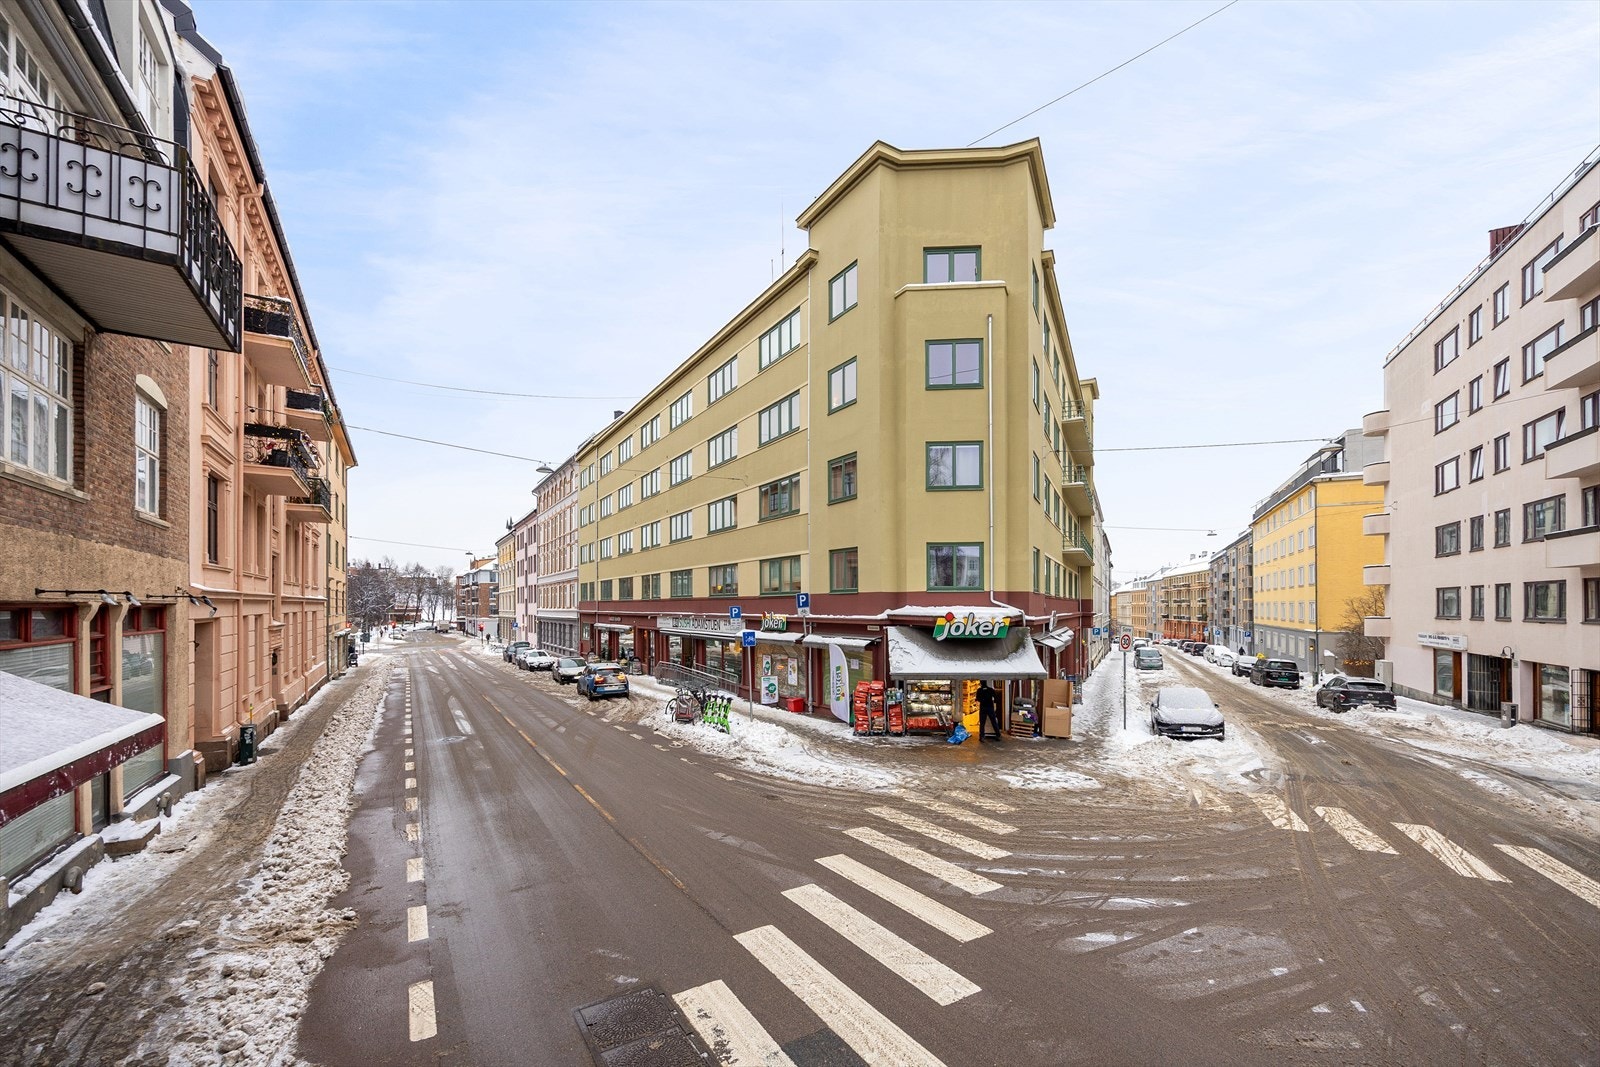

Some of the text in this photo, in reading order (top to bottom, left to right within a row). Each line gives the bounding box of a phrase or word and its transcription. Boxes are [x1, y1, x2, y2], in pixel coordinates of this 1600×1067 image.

[799, 595, 806, 606] P
[732, 608, 738, 617] P
[679, 618, 691, 628] SUSHI
[692, 618, 722, 631] ADAMSTUEN
[761, 611, 784, 632] joker
[936, 611, 1005, 642] joker
